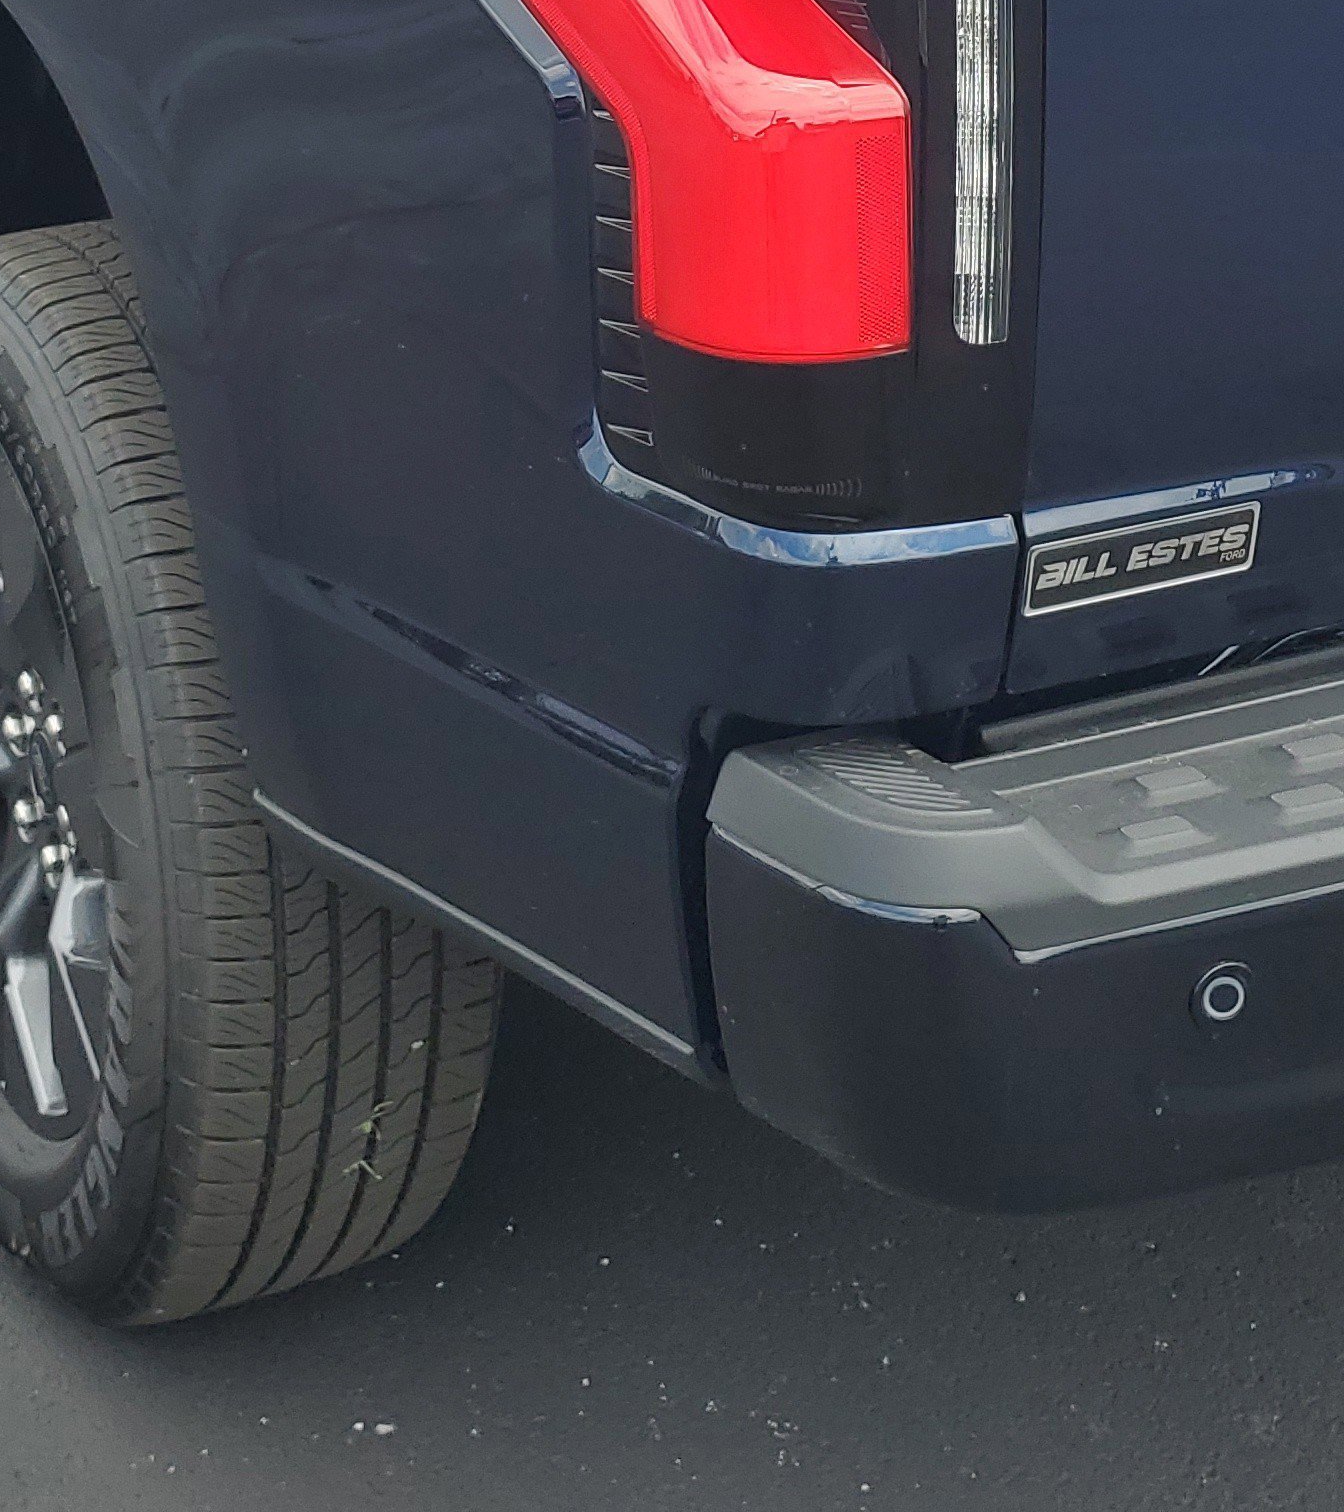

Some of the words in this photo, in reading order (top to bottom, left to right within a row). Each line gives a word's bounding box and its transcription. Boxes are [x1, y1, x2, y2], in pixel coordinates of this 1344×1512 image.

[1035, 552, 1117, 590] BILL
[1126, 524, 1250, 571] ESTES
[1219, 548, 1246, 563] FORD
